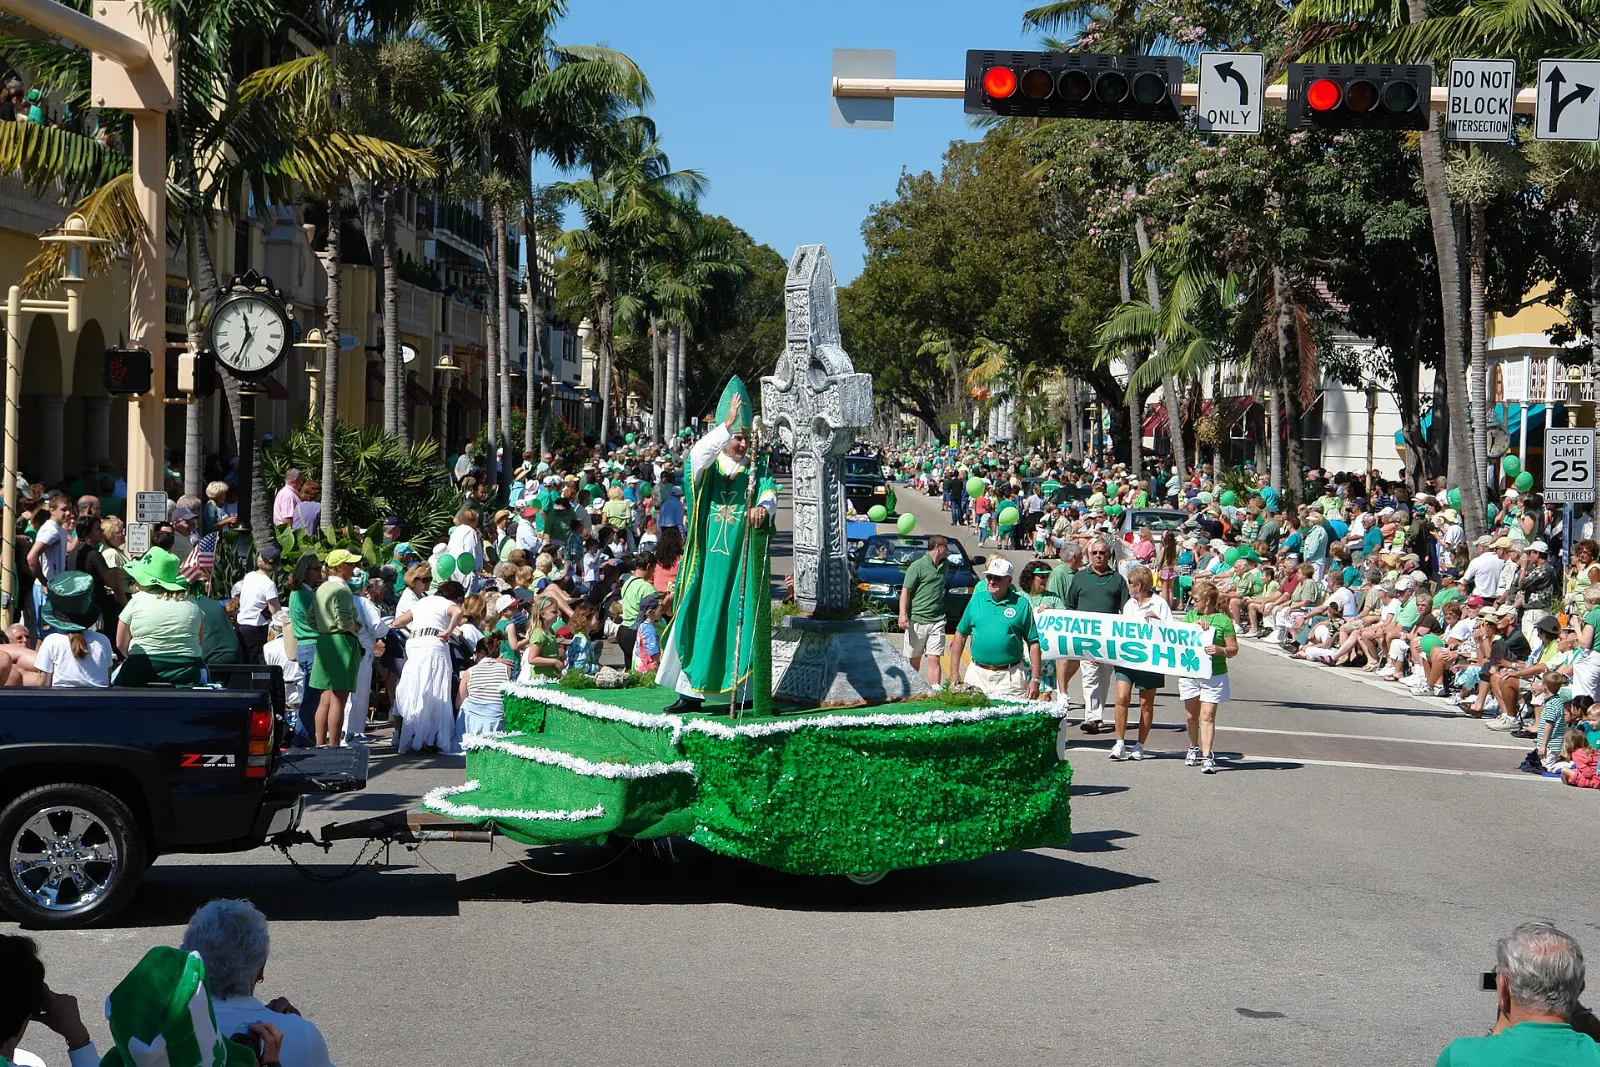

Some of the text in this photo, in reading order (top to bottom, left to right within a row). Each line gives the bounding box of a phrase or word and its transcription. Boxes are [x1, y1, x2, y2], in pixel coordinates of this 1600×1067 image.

[1453, 70, 1511, 89] DO NOT
[1451, 97, 1509, 115] BLOCK
[1207, 109, 1251, 125] ONLY
[1448, 119, 1508, 133] INTERSECTION
[1550, 435, 1590, 445] SPEED
[1554, 447, 1584, 457] LIMIT
[1550, 460, 1589, 482] 25
[1546, 491, 1592, 500] ALL STREETS
[1037, 615, 1203, 647] UPSTATE NEW YORK
[1058, 635, 1176, 668] IRISH
[180, 753, 235, 767] Z71
